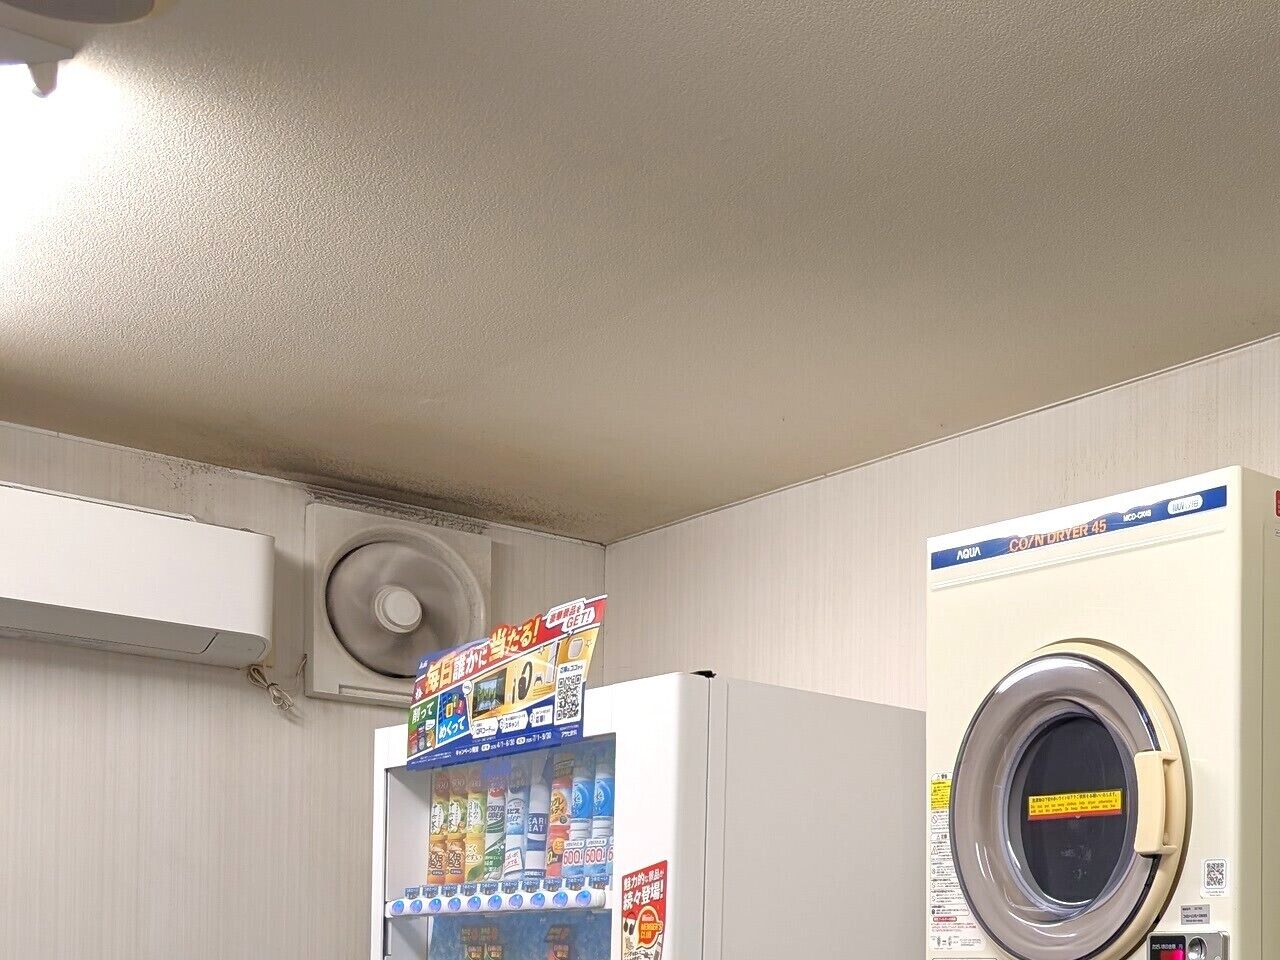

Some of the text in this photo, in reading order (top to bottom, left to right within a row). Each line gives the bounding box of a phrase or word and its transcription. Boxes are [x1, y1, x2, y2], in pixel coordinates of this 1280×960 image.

[1046, 523, 1089, 544] DRYER
[1091, 519, 1107, 534] 45
[956, 546, 982, 560] AQUA
[567, 610, 592, 629] GET!
